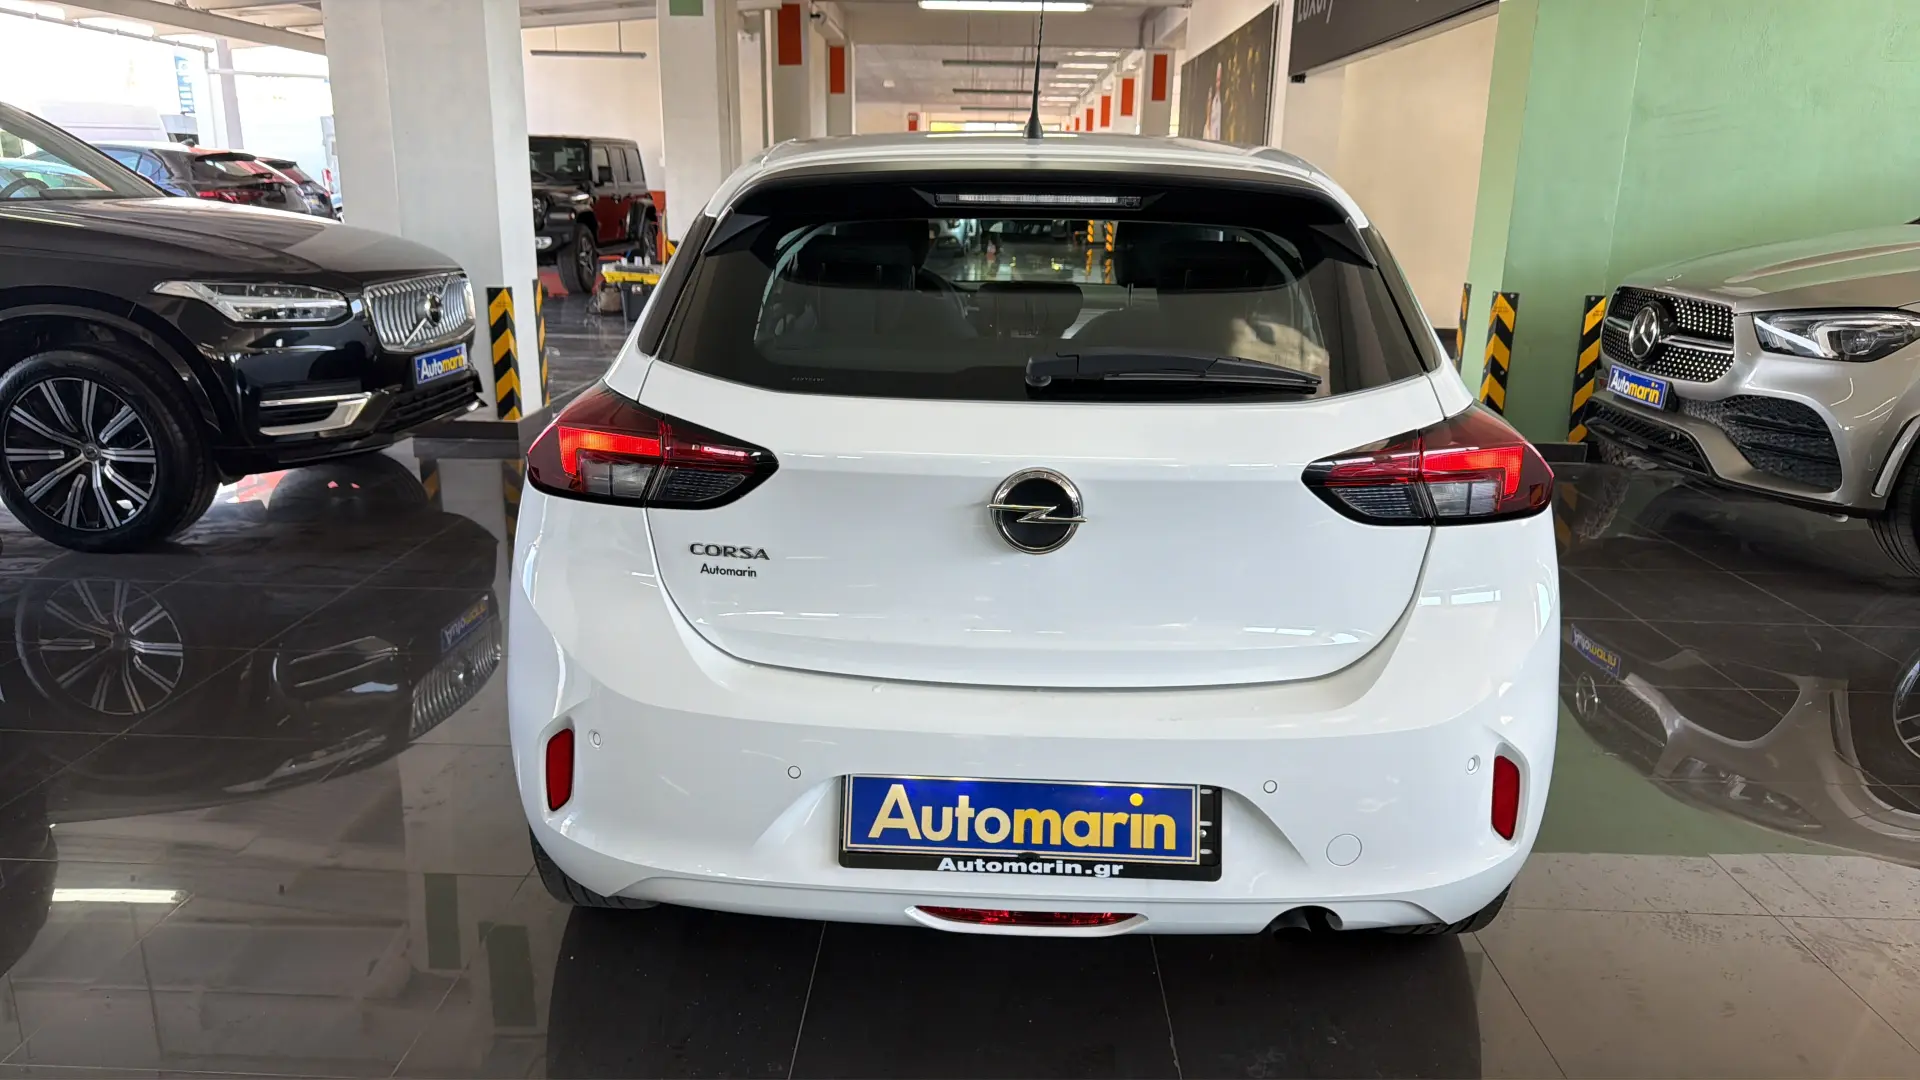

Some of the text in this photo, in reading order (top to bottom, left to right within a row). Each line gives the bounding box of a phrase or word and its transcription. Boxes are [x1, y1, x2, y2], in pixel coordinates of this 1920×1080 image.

[421, 349, 464, 380] Automarin
[1610, 369, 1660, 404] Automarin
[689, 543, 770, 560] CORSA
[700, 563, 757, 577] Automarin
[868, 783, 1177, 850] Automarin
[936, 856, 1125, 878] Automarin.gr
